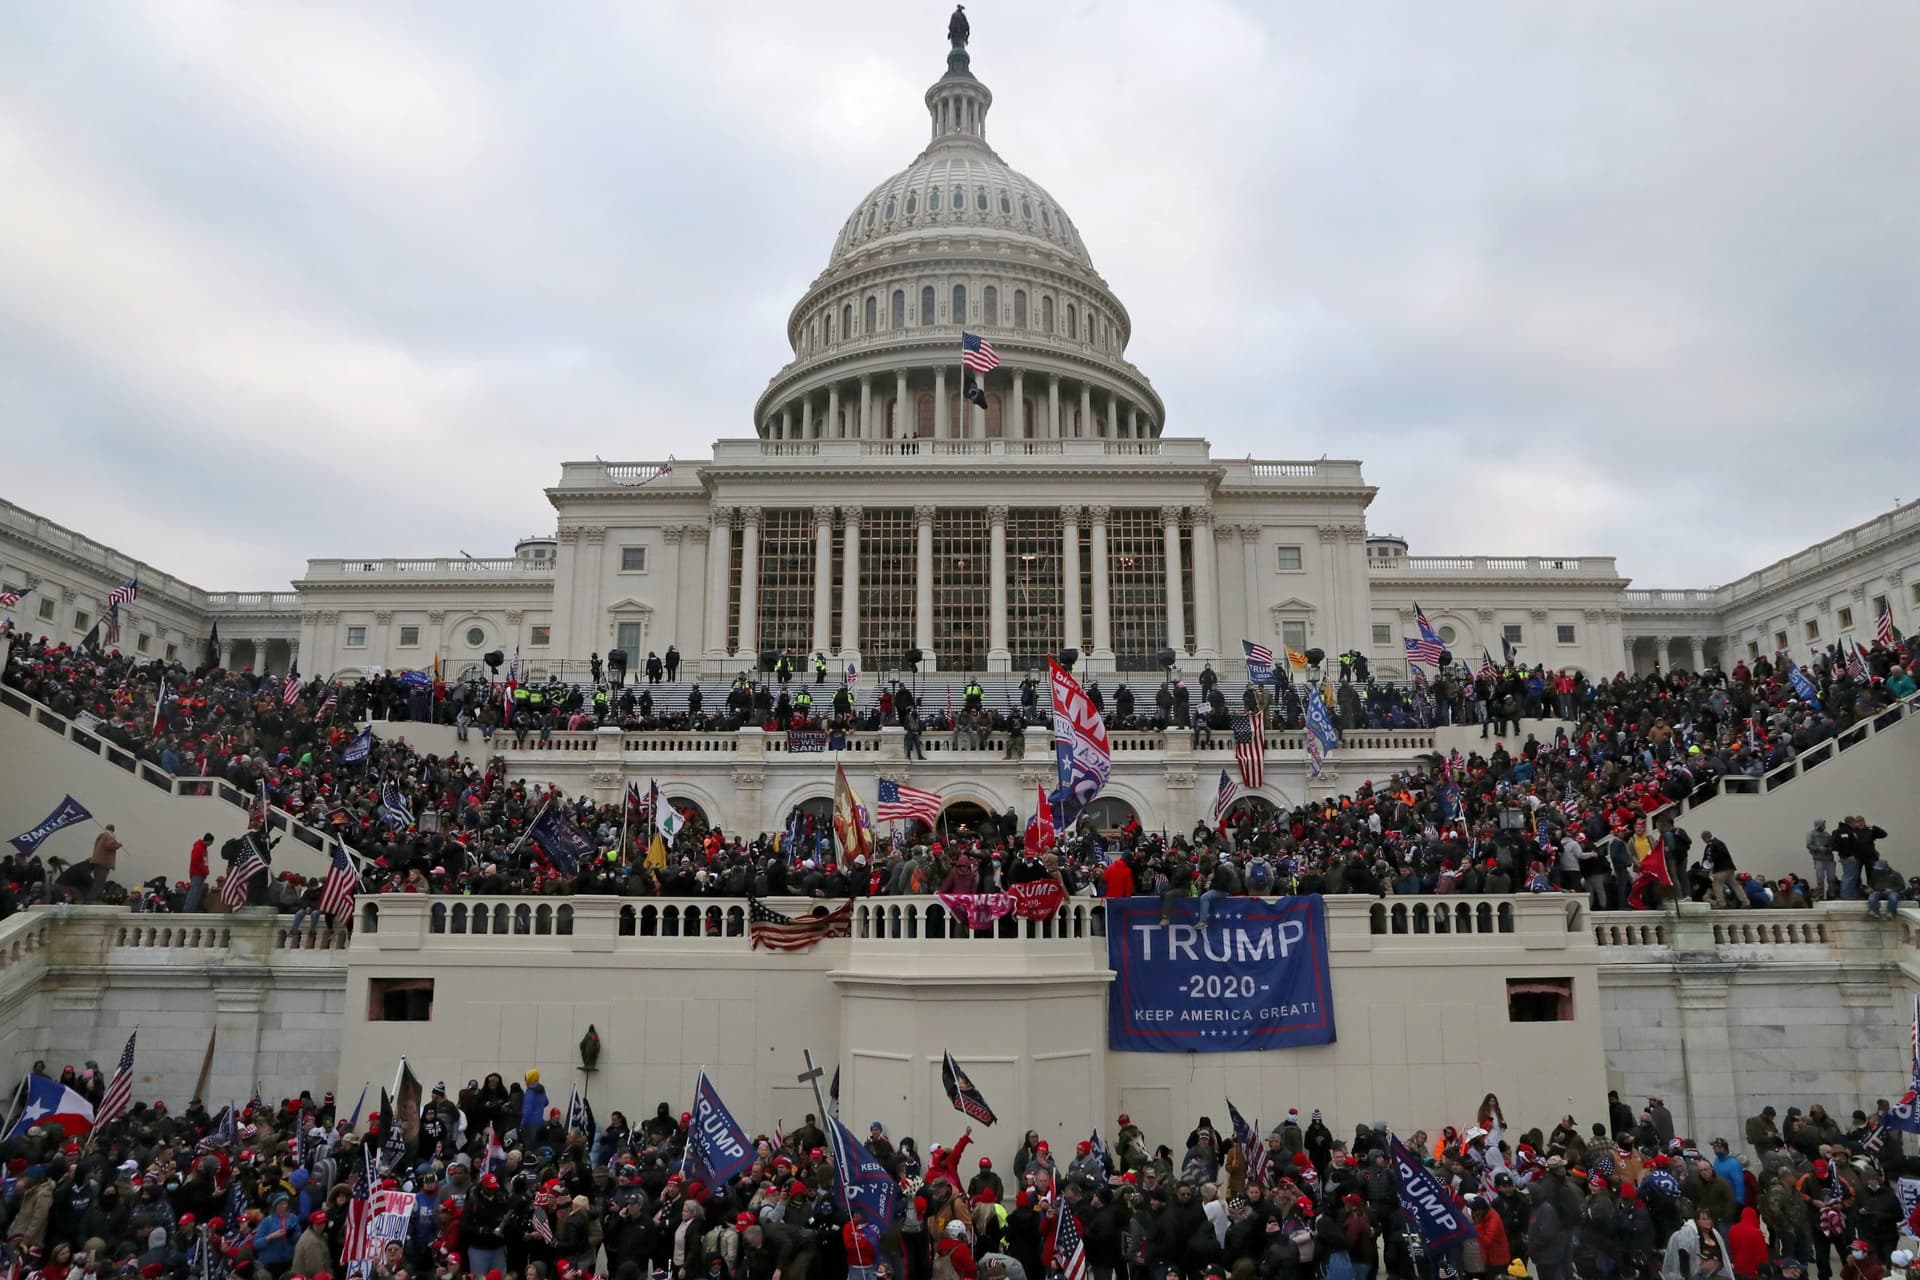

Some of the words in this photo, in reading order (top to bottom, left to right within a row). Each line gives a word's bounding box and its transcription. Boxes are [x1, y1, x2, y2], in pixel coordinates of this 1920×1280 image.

[1016, 883, 1059, 898] RUMP
[1132, 919, 1304, 963] TRUMP
[1135, 1009, 1174, 1021] KEEP
[1180, 1009, 1253, 1022] AMERICA
[1259, 1001, 1317, 1020] GREAT!
[698, 1092, 744, 1158] RUMP
[1396, 1156, 1457, 1230] RUMP
